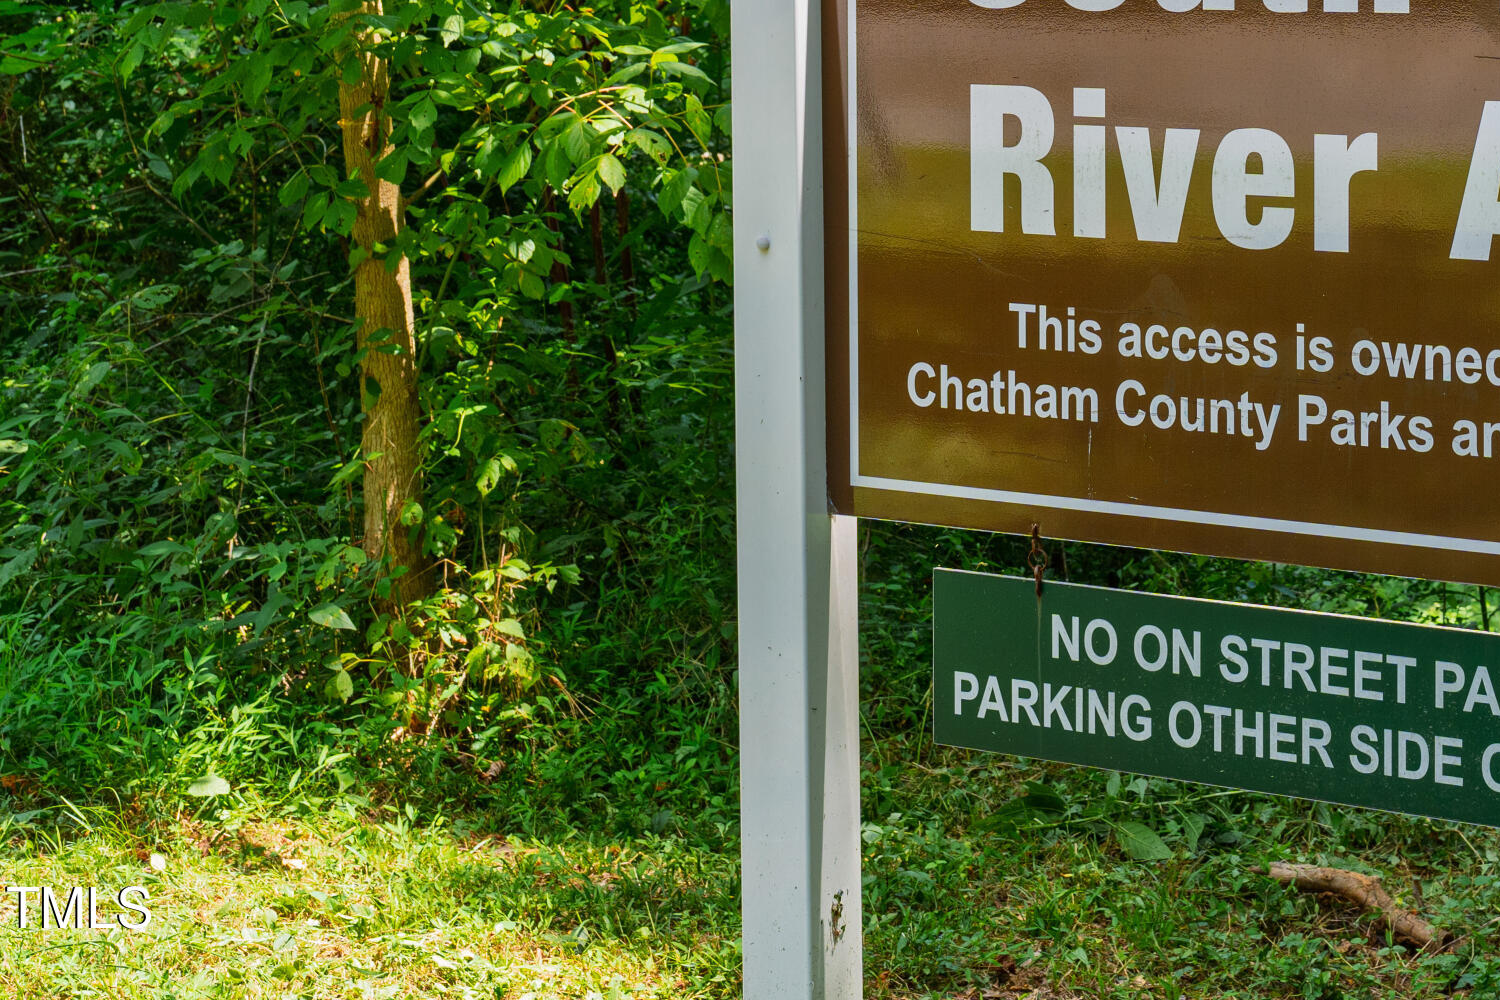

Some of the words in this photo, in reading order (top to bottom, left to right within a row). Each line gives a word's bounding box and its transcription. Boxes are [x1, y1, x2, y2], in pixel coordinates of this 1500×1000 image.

[971, 84, 1377, 252] River
[1009, 303, 1102, 354] This
[1119, 323, 1277, 368] access
[1297, 324, 1333, 372] is
[908, 362, 1098, 422] Chatham
[1116, 380, 1280, 450] County
[1299, 395, 1433, 452] Parks
[1052, 614, 1117, 665] NO
[1134, 625, 1201, 677] ON
[1220, 635, 1416, 703] STREET
[955, 671, 1152, 741] PARKING
[1169, 701, 1334, 768] OTHER
[1350, 725, 1463, 786] SIDE
